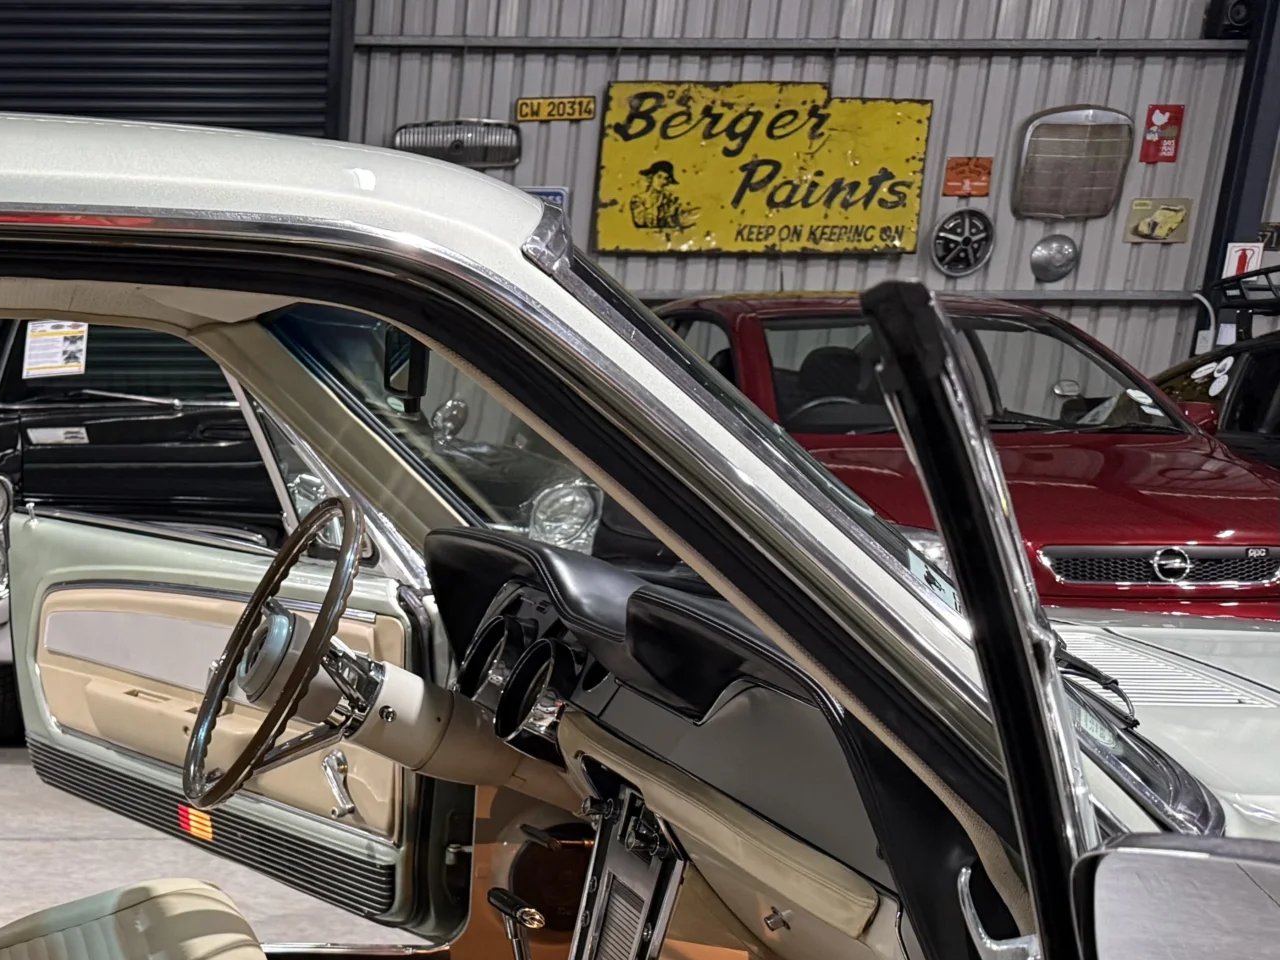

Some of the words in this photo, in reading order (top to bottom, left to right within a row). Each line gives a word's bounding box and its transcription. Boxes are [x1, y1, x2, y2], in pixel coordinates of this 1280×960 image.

[519, 102, 540, 118] CW
[547, 101, 593, 117] 20314
[614, 90, 832, 157] Berger
[730, 158, 913, 211] Paints
[734, 223, 775, 243] KEEP
[778, 224, 803, 243] ON
[807, 224, 874, 244] KEEPING
[879, 224, 905, 243] ON
